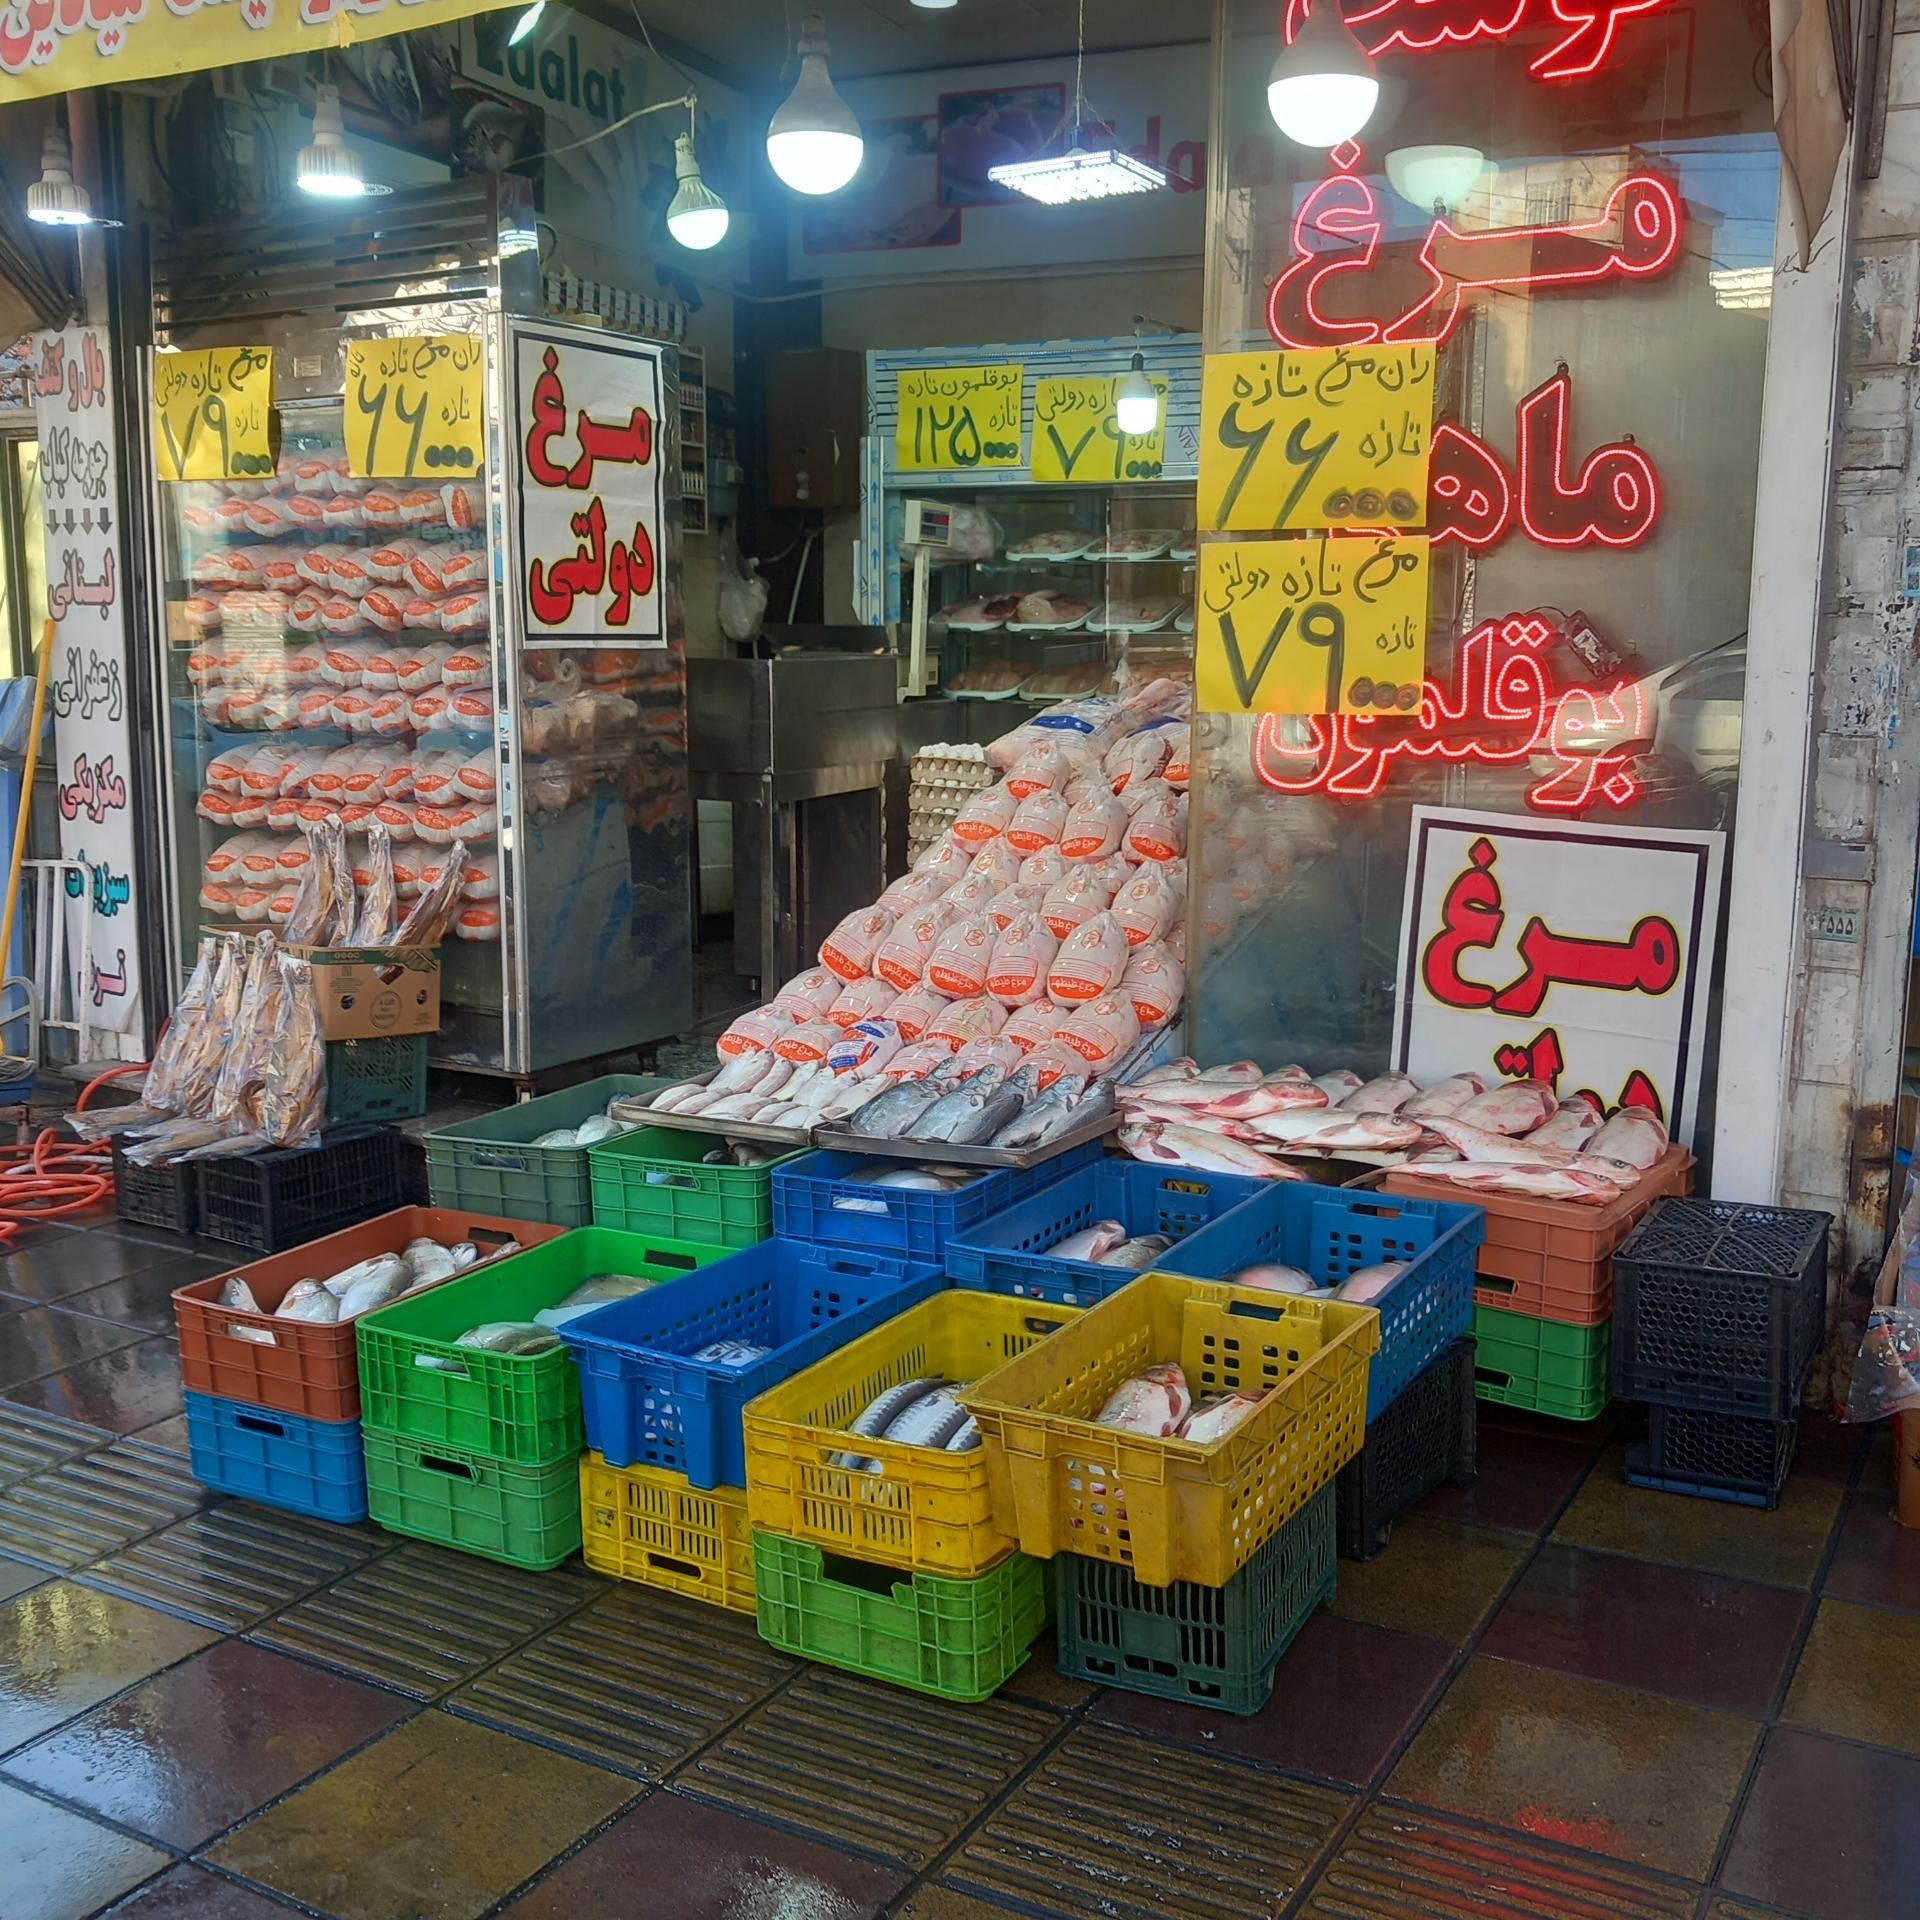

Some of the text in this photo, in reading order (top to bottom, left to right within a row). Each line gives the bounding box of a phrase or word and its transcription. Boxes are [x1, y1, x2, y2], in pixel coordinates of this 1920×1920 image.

[1267, 137, 1678, 350] مرغ
[67, 359, 78, 412] و
[156, 347, 268, 408] مرغ تازه دولتی
[379, 339, 408, 378] تازه
[1232, 347, 1430, 407] ران مرغ تازه
[235, 402, 259, 437] تازه
[441, 386, 470, 426] تازه
[525, 345, 652, 490] مرغ
[989, 395, 1017, 432] تازه
[1035, 385, 1084, 422] دولتی
[1358, 410, 1421, 468] تازه
[1430, 376, 1657, 545] ماه
[47, 546, 116, 622] لبنانی
[529, 496, 655, 625] دولتی
[1203, 537, 1419, 613] مرغ تازه دولتی
[1376, 615, 1417, 655] تازه
[53, 646, 122, 721] زعفرانی
[59, 752, 127, 824] مکزیکی
[1422, 837, 1680, 1017] مرغ
